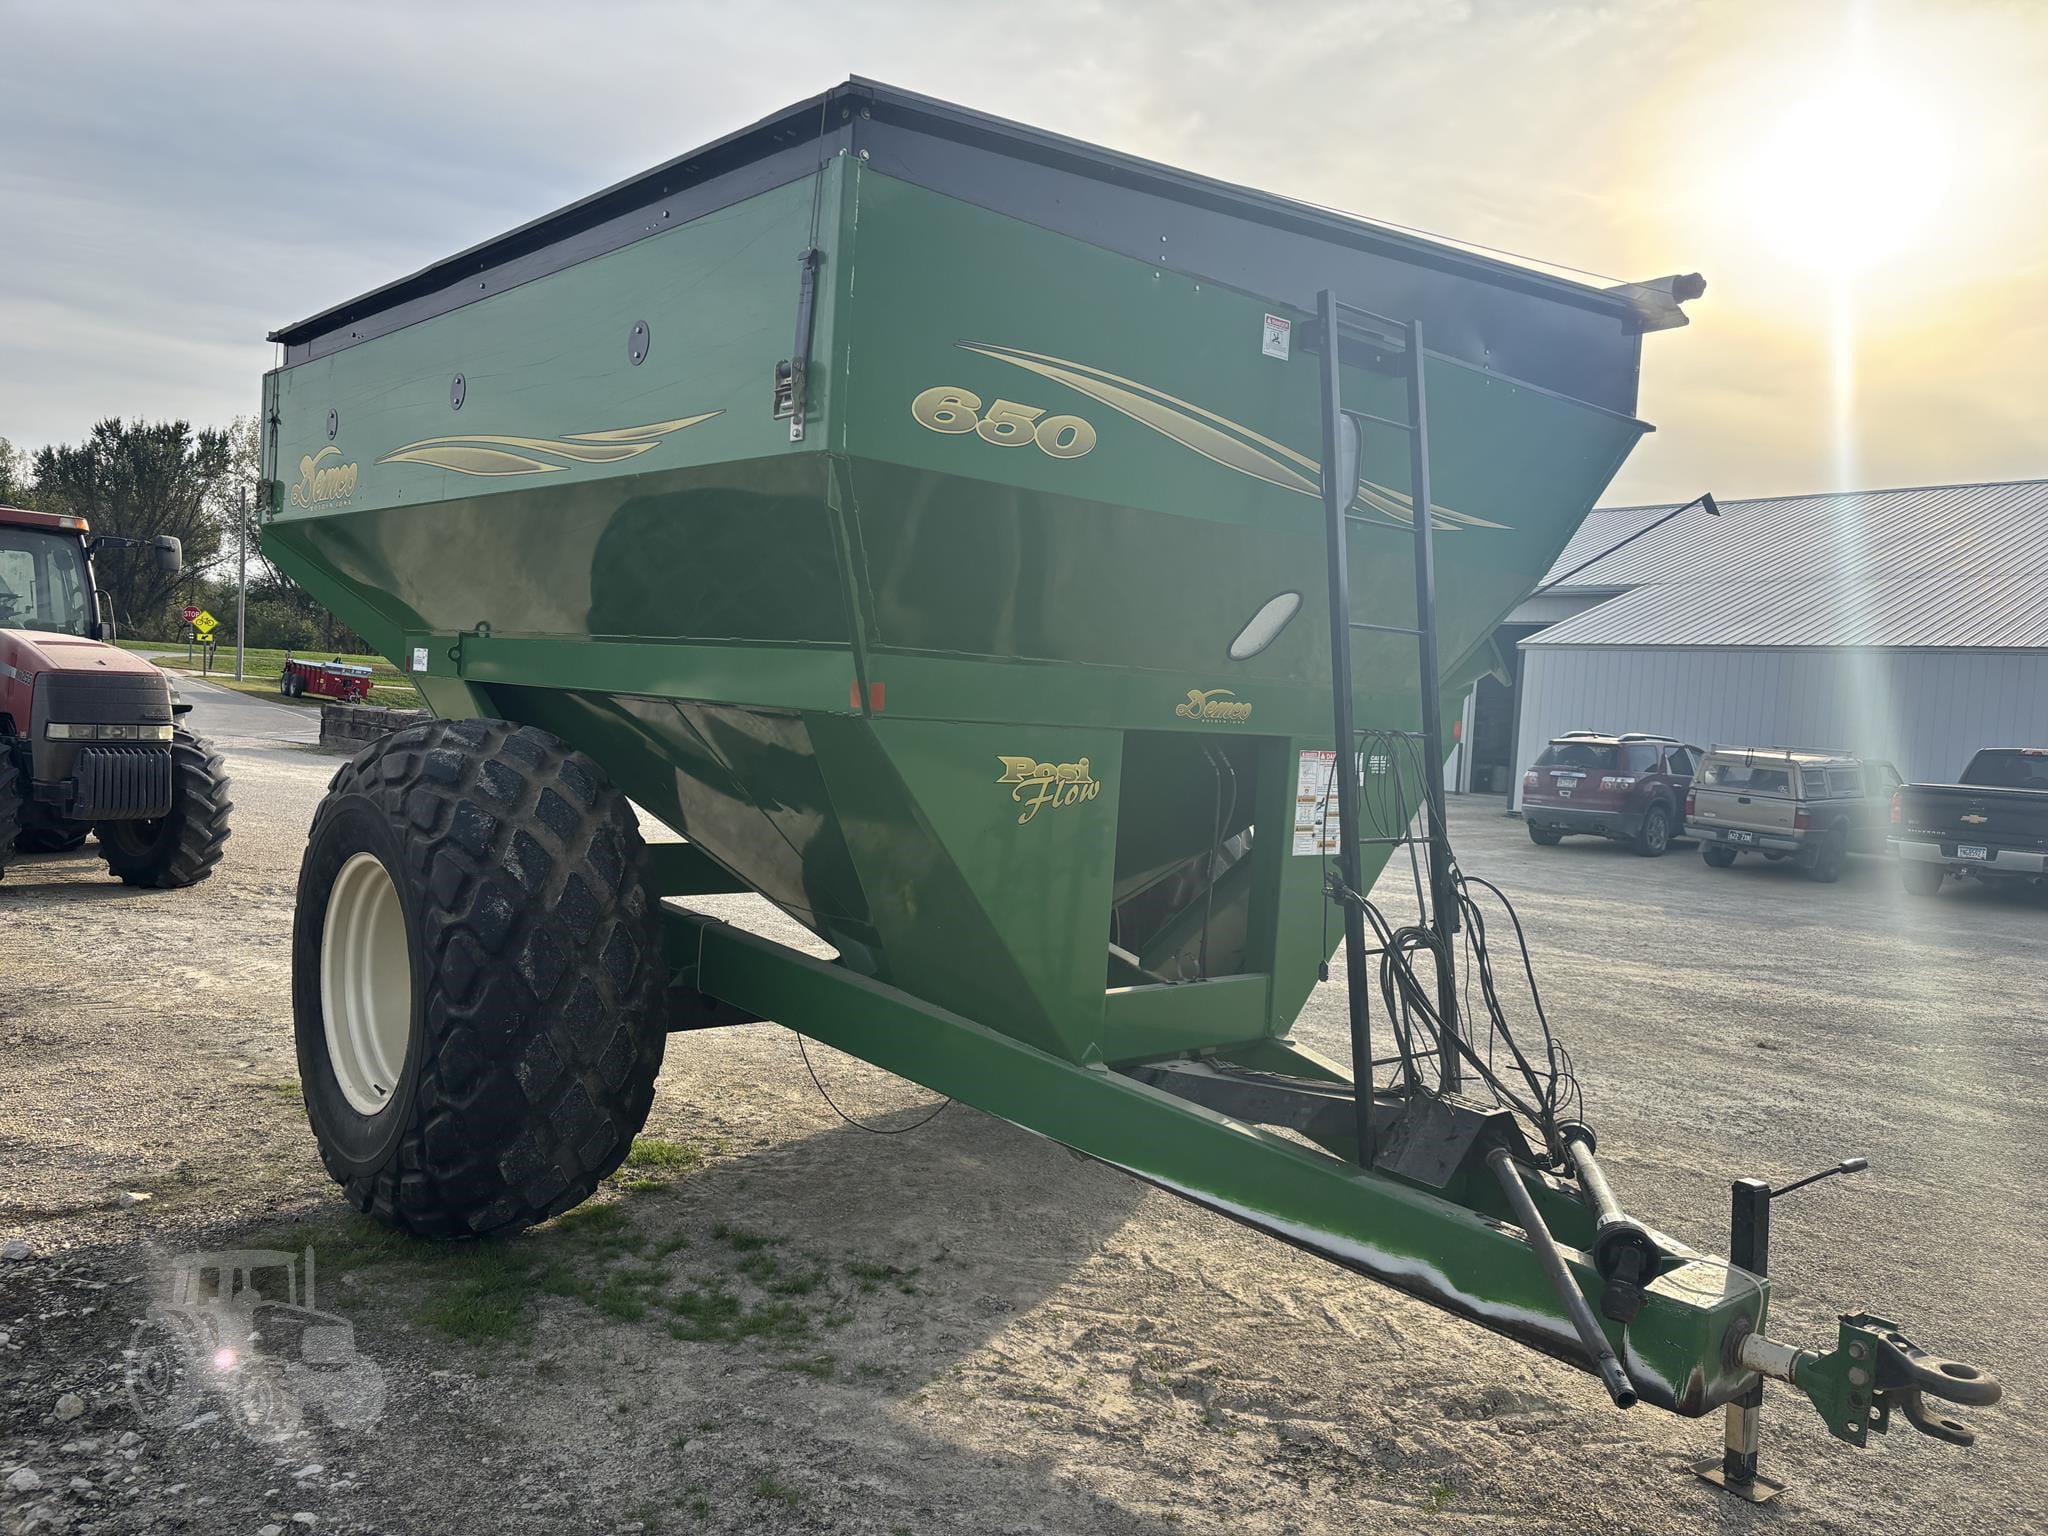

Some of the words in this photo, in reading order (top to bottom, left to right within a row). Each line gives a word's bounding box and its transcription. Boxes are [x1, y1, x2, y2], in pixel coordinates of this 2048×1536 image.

[911, 386, 1097, 459] 650
[291, 446, 358, 509] Demco
[184, 610, 200, 618] STOP
[1175, 688, 1252, 720] Demco
[994, 755, 1095, 784] Posi
[1012, 776, 1101, 825] Flow
